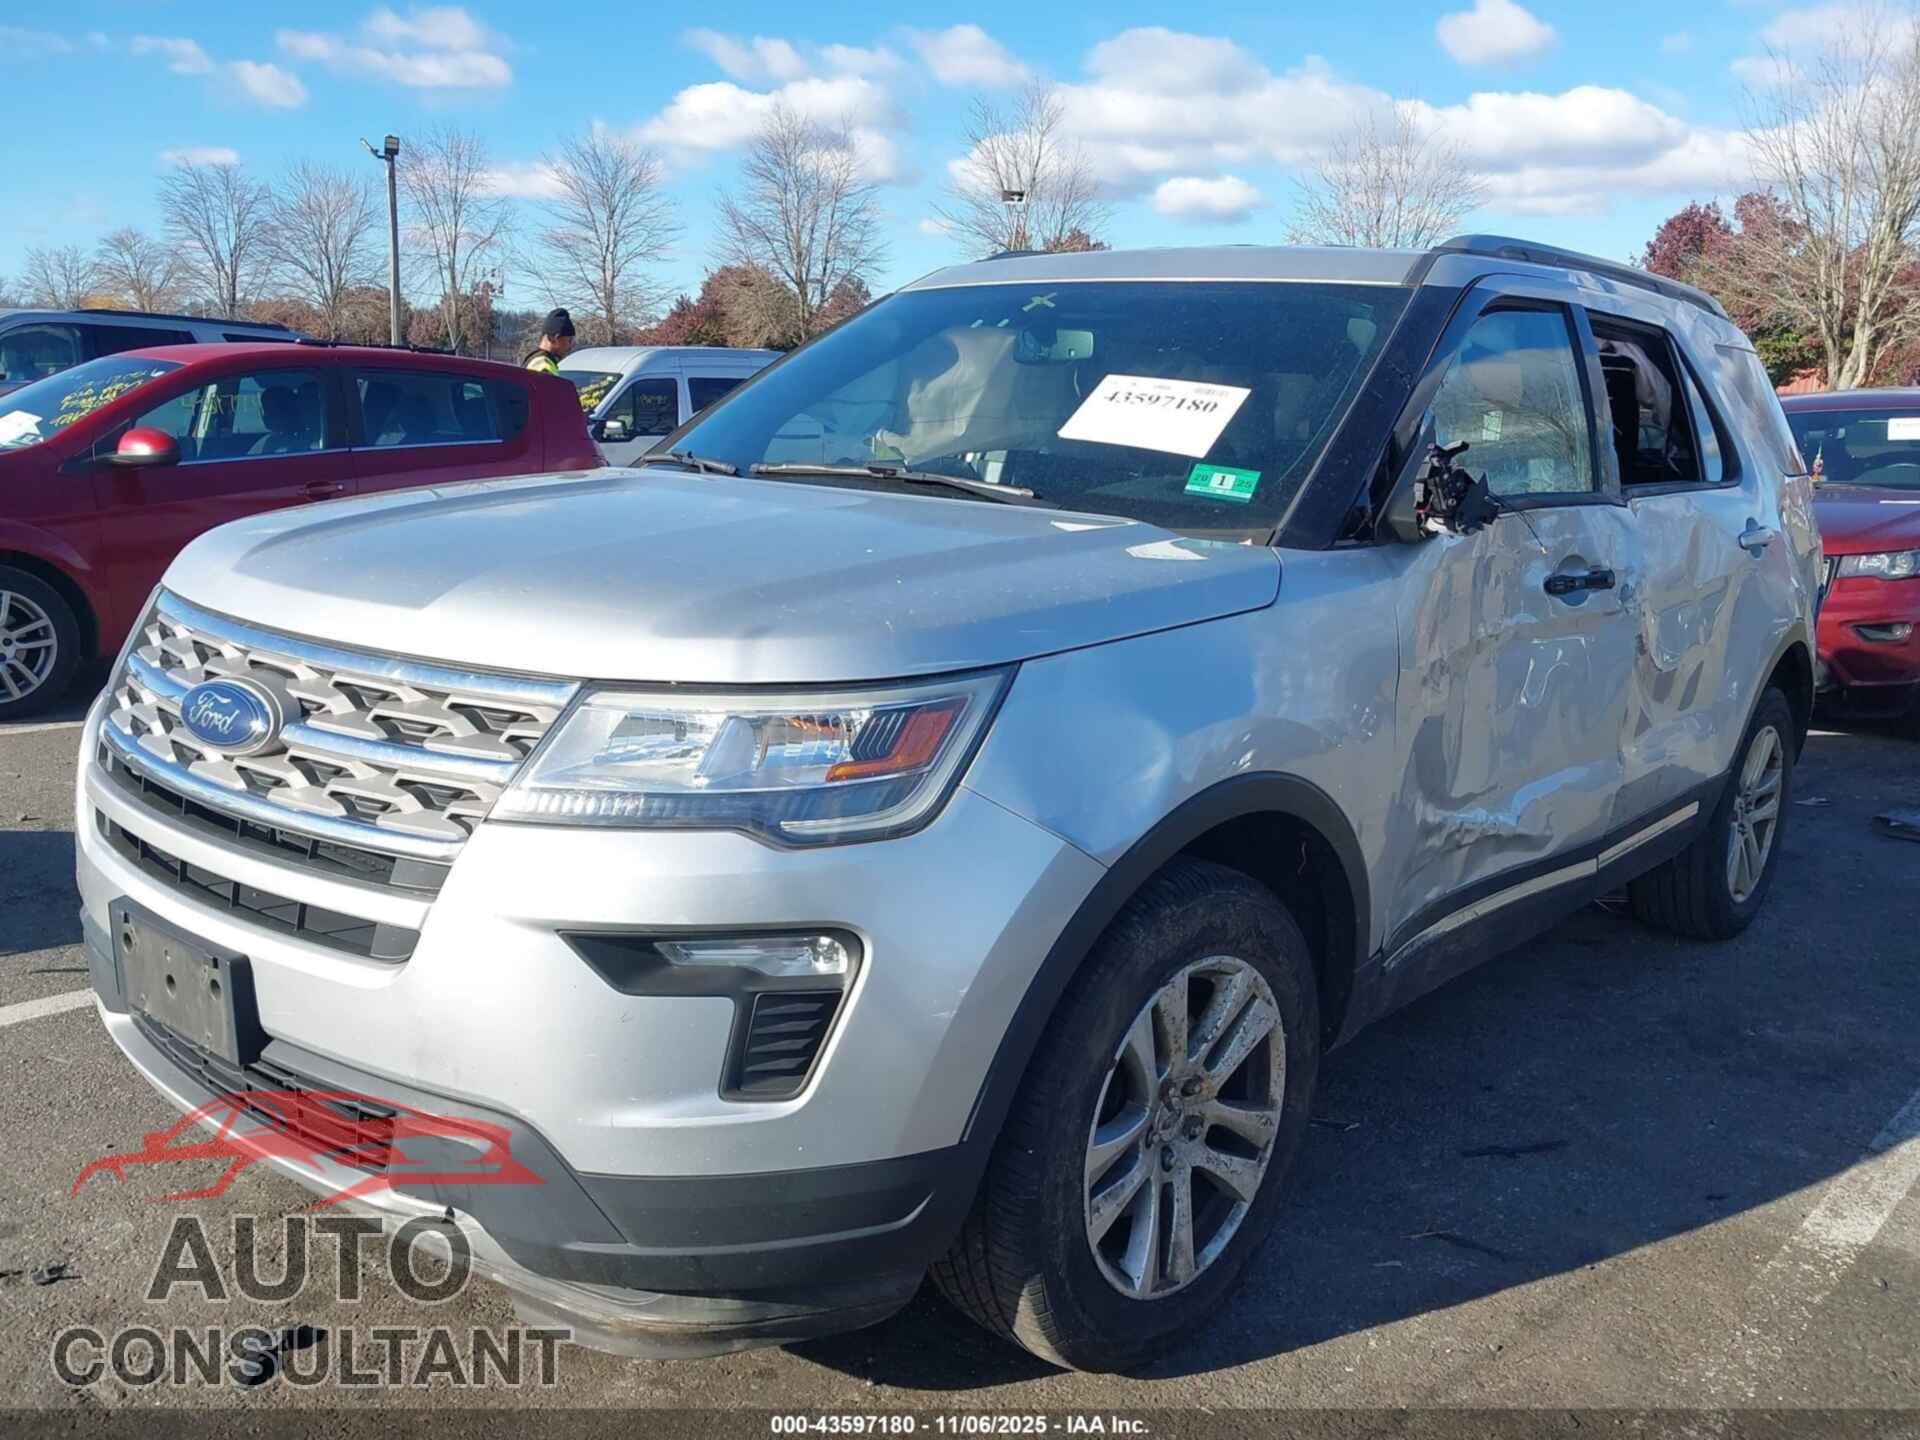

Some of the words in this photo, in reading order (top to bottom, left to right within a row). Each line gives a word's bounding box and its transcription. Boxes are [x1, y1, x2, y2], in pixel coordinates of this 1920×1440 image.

[1104, 391, 1218, 412] 43597180
[1217, 475, 1227, 487] 1
[189, 690, 240, 734] Ford
